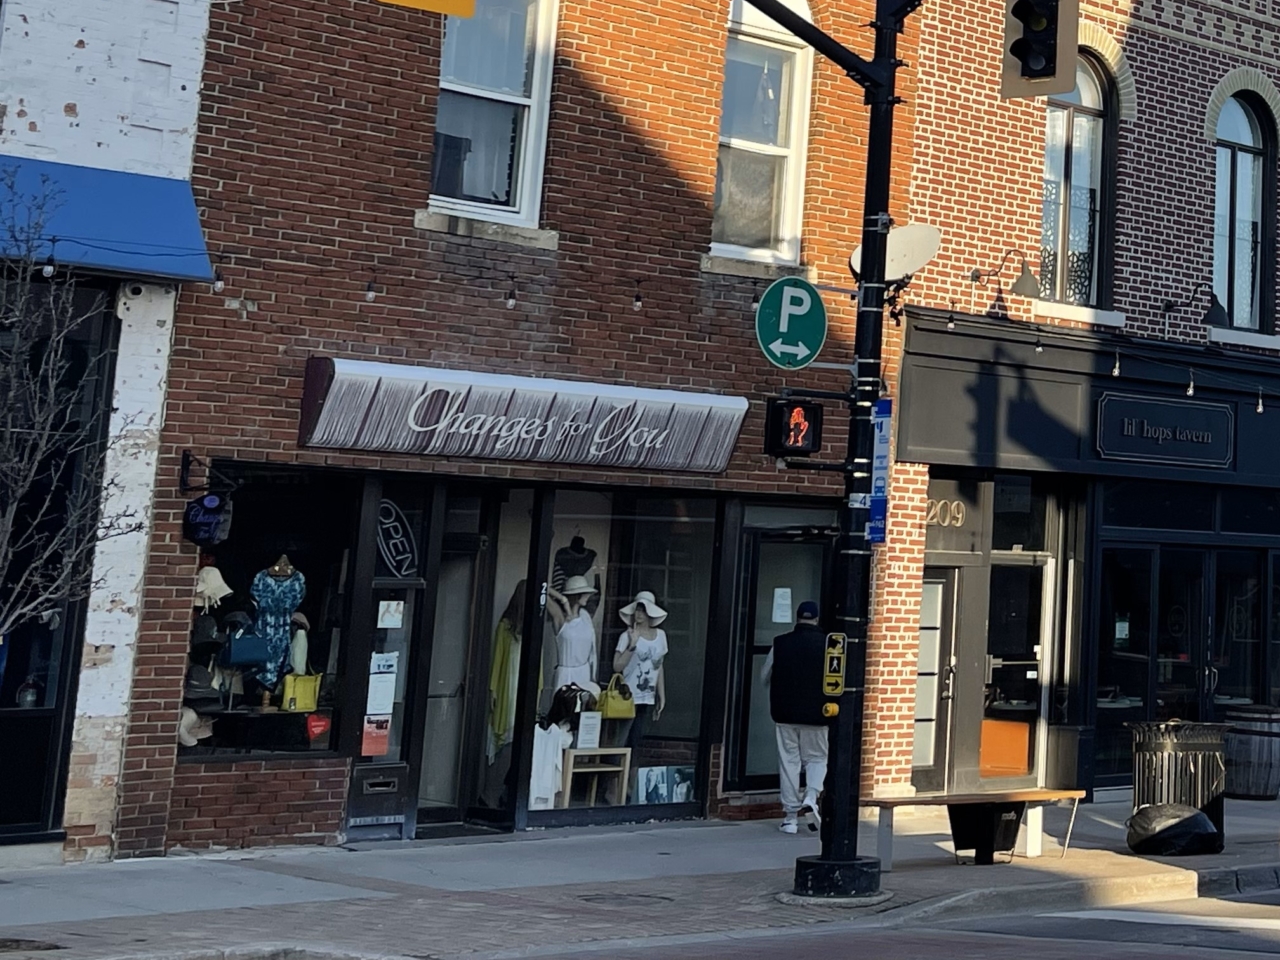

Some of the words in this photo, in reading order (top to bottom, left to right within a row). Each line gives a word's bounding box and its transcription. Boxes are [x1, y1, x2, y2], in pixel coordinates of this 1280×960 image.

[778, 285, 812, 333] P
[407, 388, 557, 454] Changes
[555, 408, 593, 441] for
[589, 400, 670, 456] You
[1142, 420, 1173, 444] hops
[1175, 425, 1212, 443] tavern
[926, 498, 966, 528] 209
[379, 503, 417, 575] OPEN
